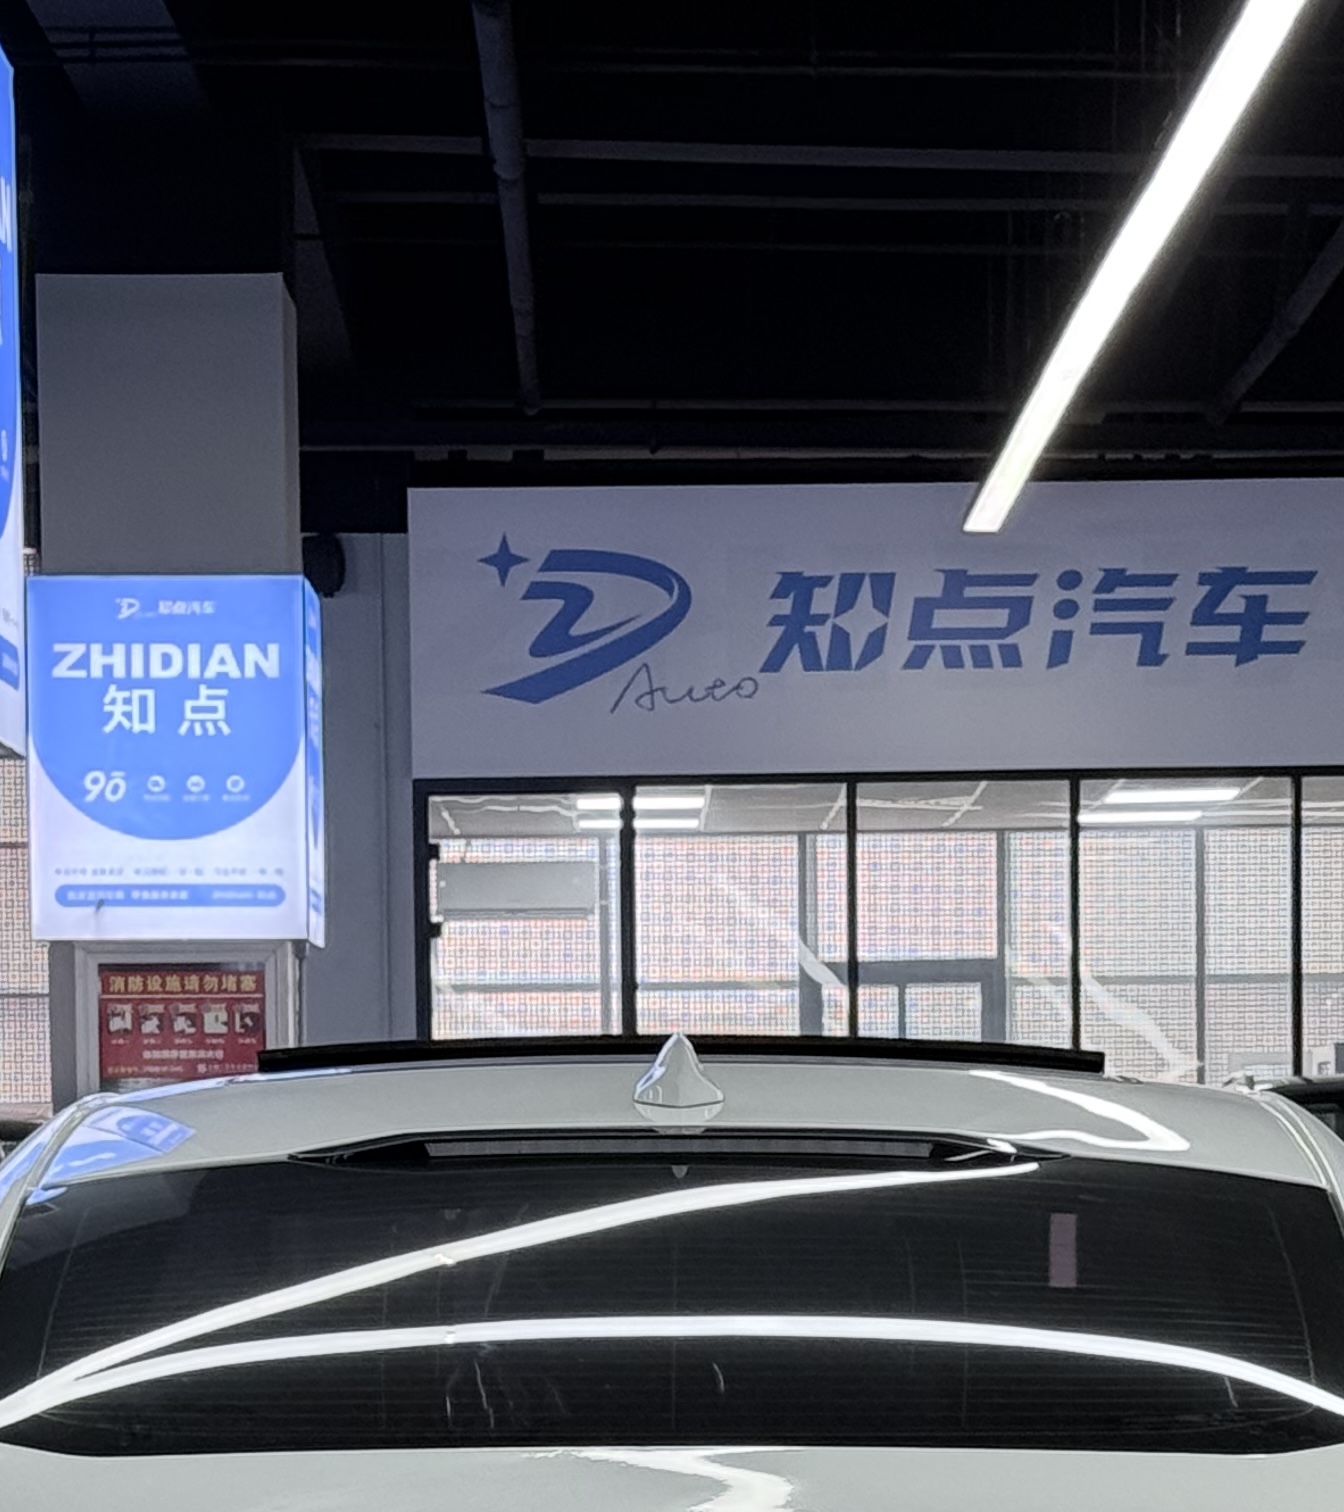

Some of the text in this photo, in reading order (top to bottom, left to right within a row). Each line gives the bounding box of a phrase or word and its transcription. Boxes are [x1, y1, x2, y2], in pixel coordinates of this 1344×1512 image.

[759, 566, 1319, 673] 知点汽车
[52, 643, 279, 678] ZHIDIAN
[103, 684, 231, 737] 知点
